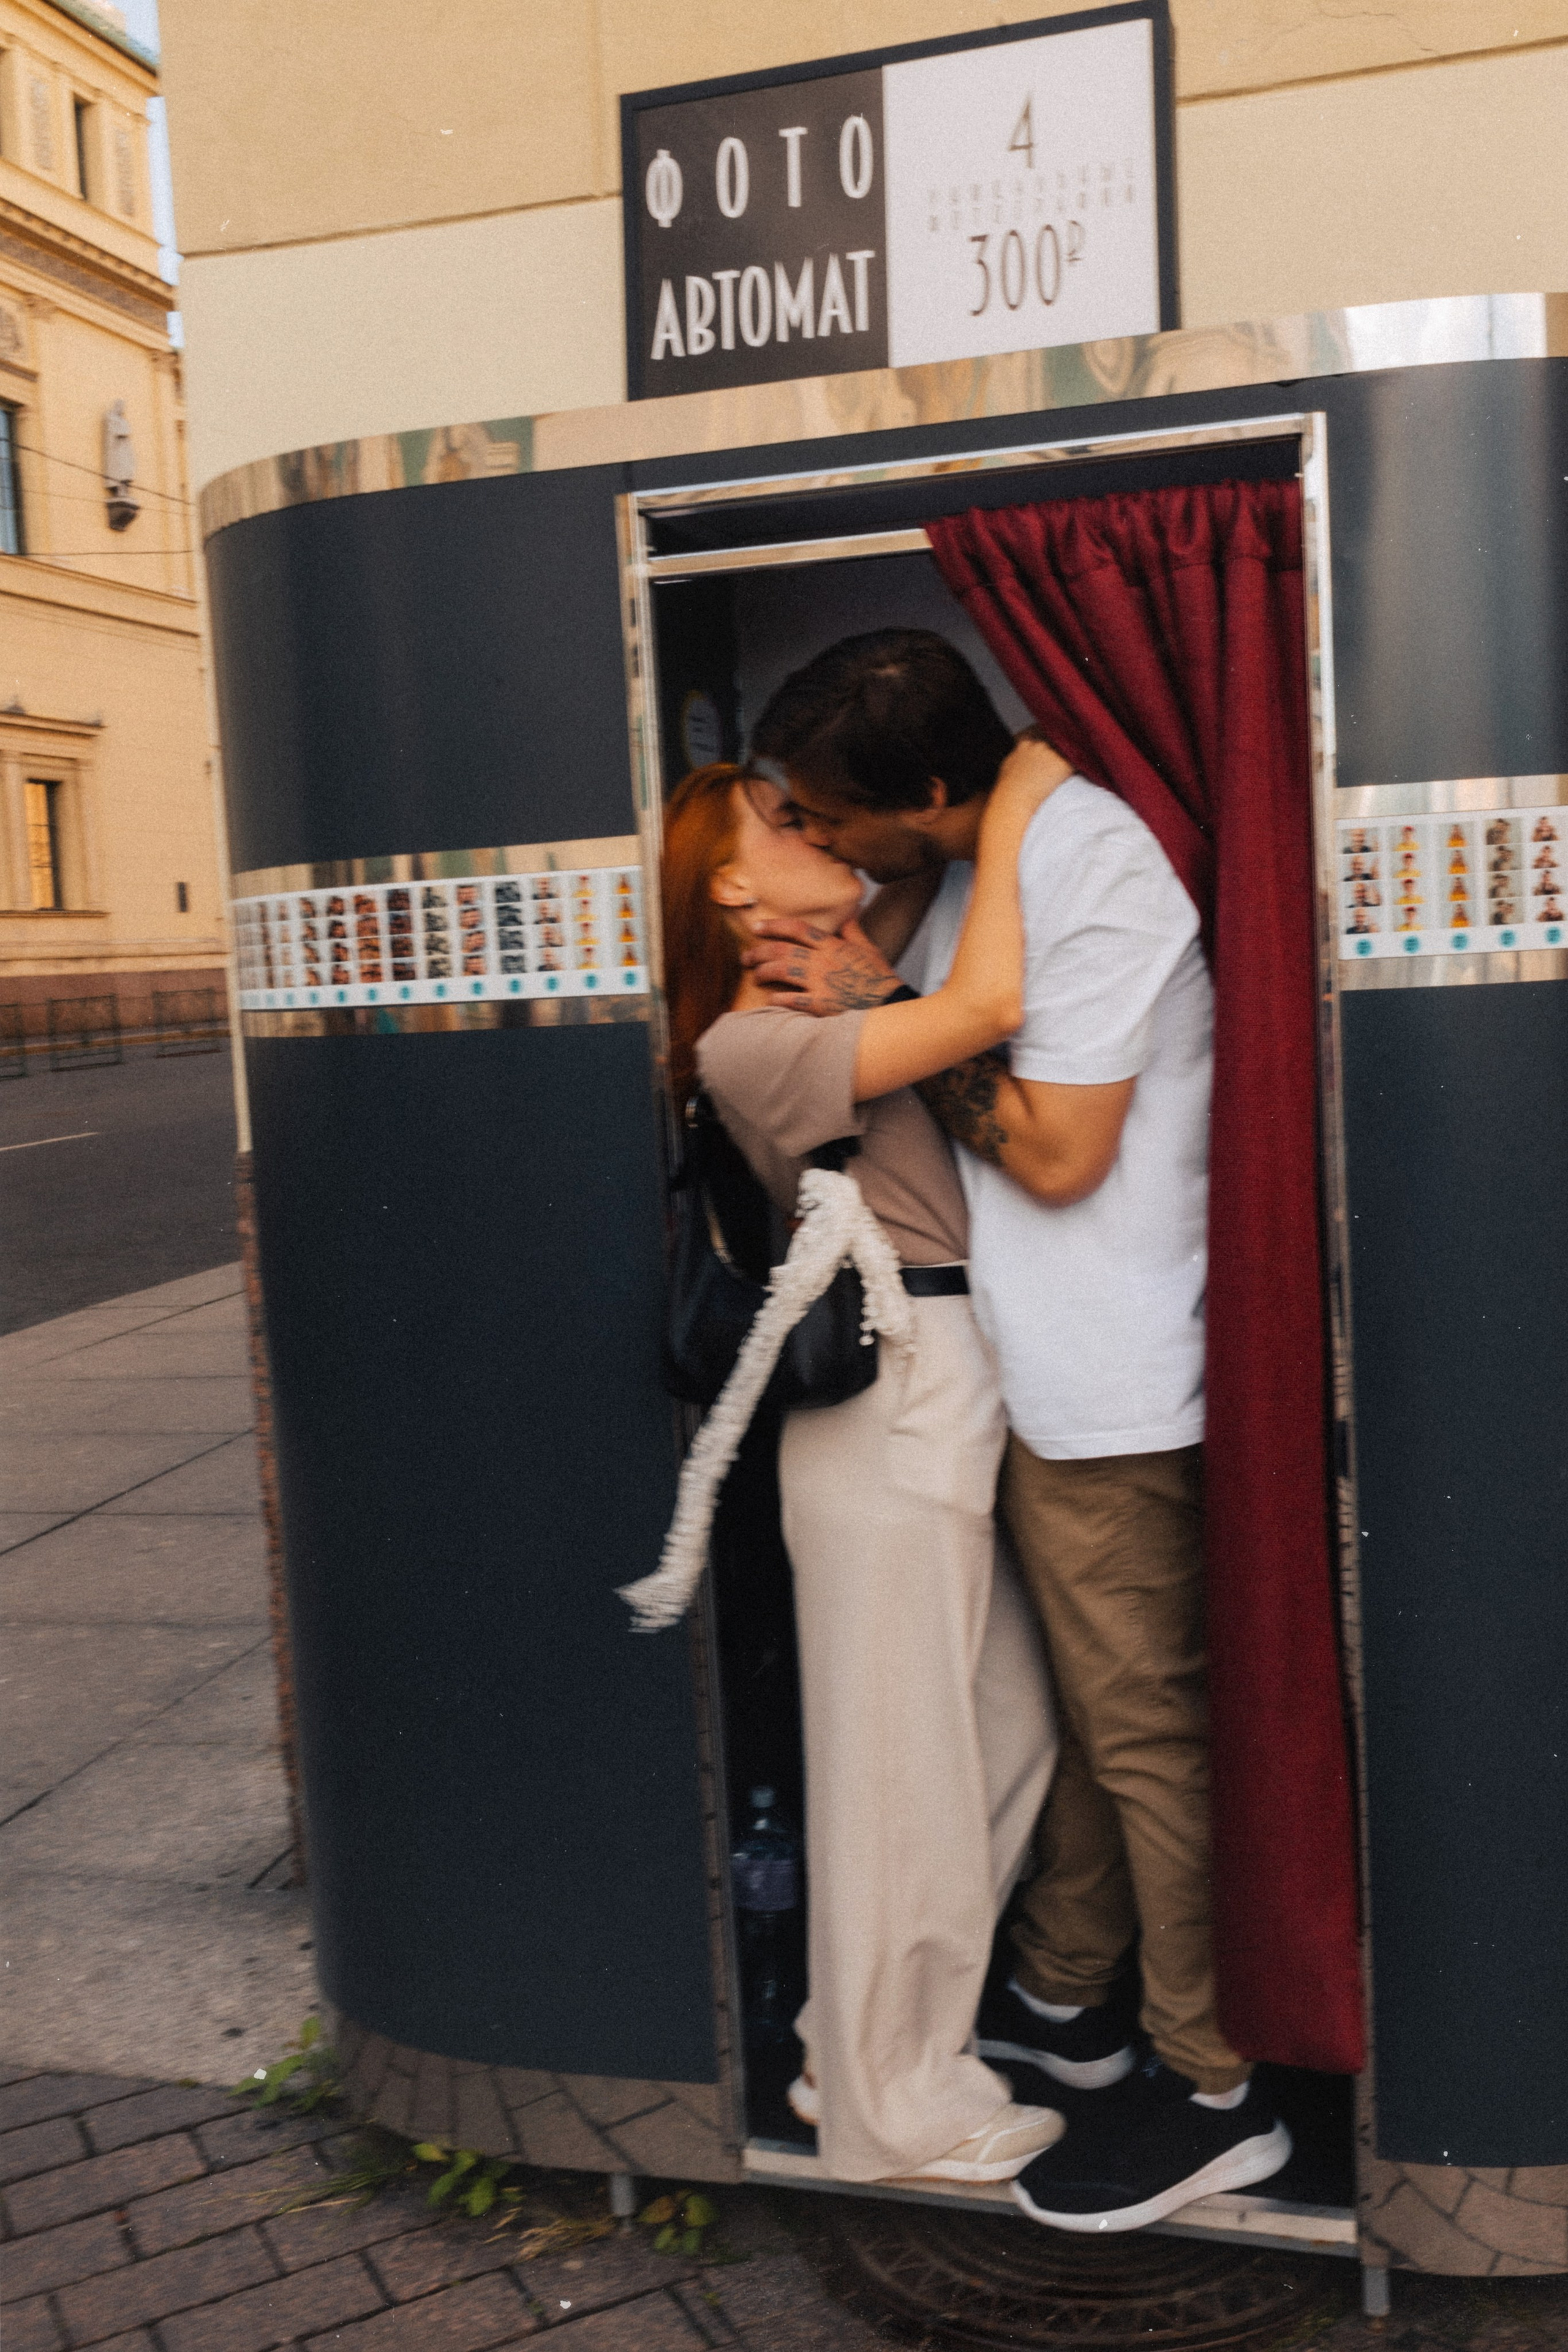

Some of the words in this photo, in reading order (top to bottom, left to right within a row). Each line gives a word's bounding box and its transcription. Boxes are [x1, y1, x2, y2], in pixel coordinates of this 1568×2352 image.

[645, 115, 874, 228] ФОТО
[1008, 94, 1034, 169] 4
[650, 250, 876, 360] АВТОМАТ
